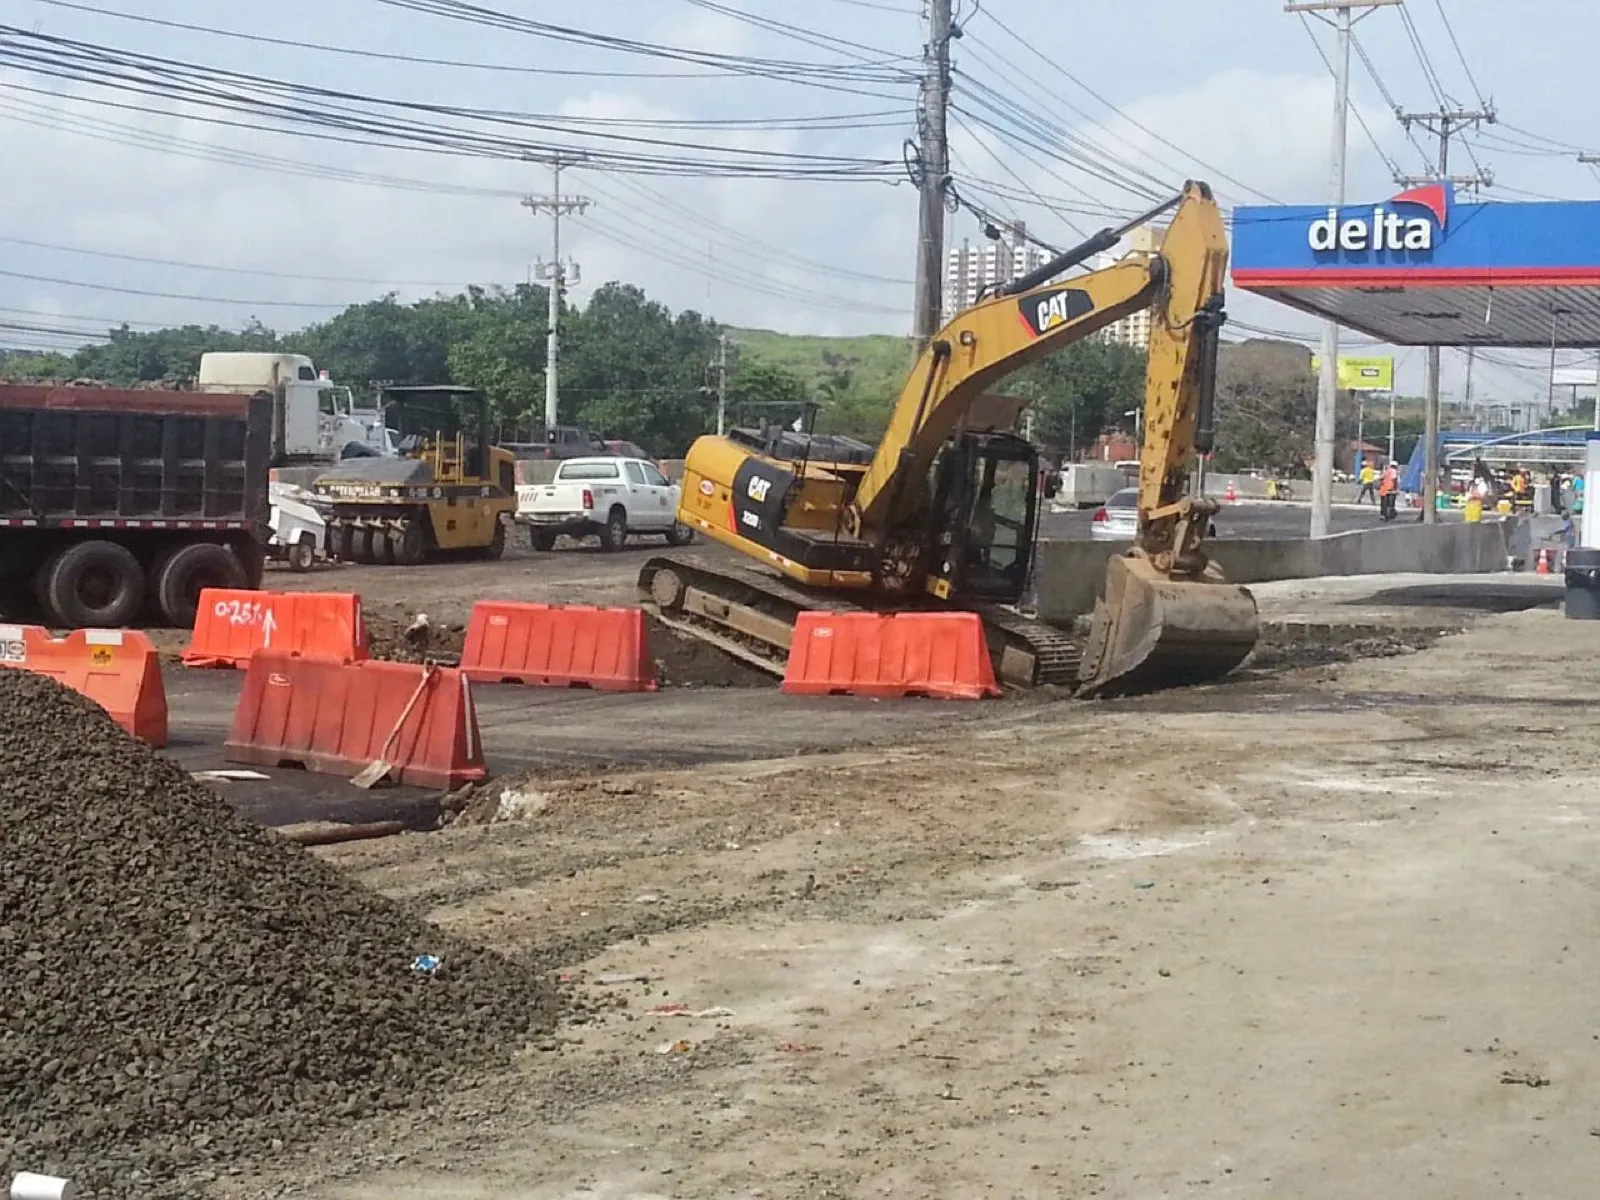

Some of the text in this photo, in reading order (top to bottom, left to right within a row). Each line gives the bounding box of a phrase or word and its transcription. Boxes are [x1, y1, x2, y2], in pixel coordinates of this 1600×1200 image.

[1308, 208, 1431, 250] delta
[1037, 290, 1068, 331] CAT
[748, 475, 771, 502] CAT
